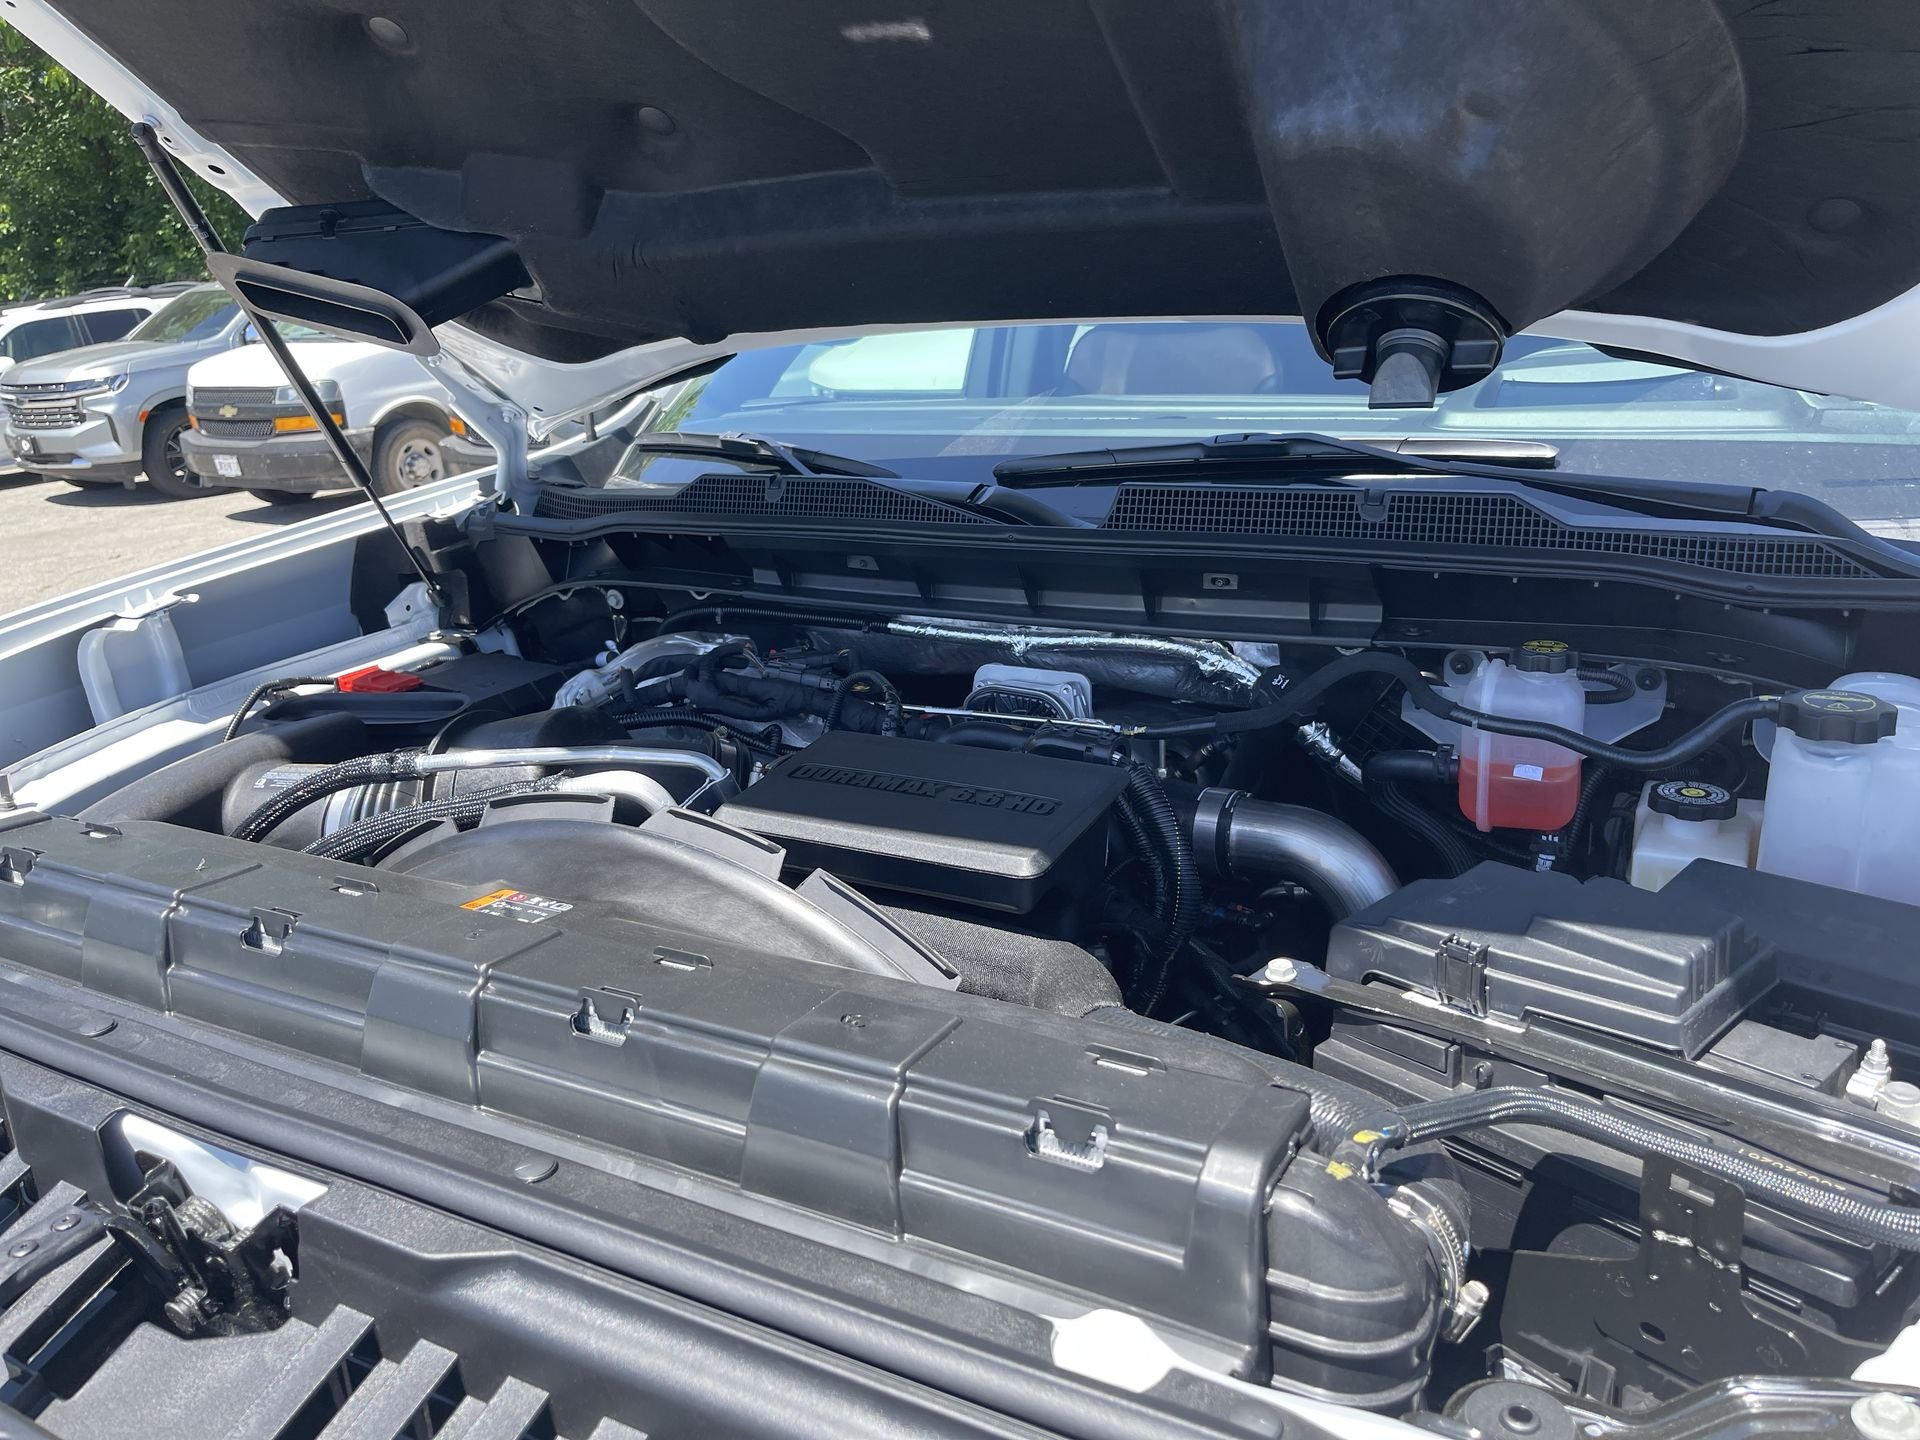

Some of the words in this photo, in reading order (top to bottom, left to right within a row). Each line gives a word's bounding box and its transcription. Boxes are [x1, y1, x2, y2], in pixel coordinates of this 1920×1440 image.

[790, 766, 941, 797] DURAMAX
[951, 788, 1004, 808] 6.6
[1005, 794, 1056, 815] HD
